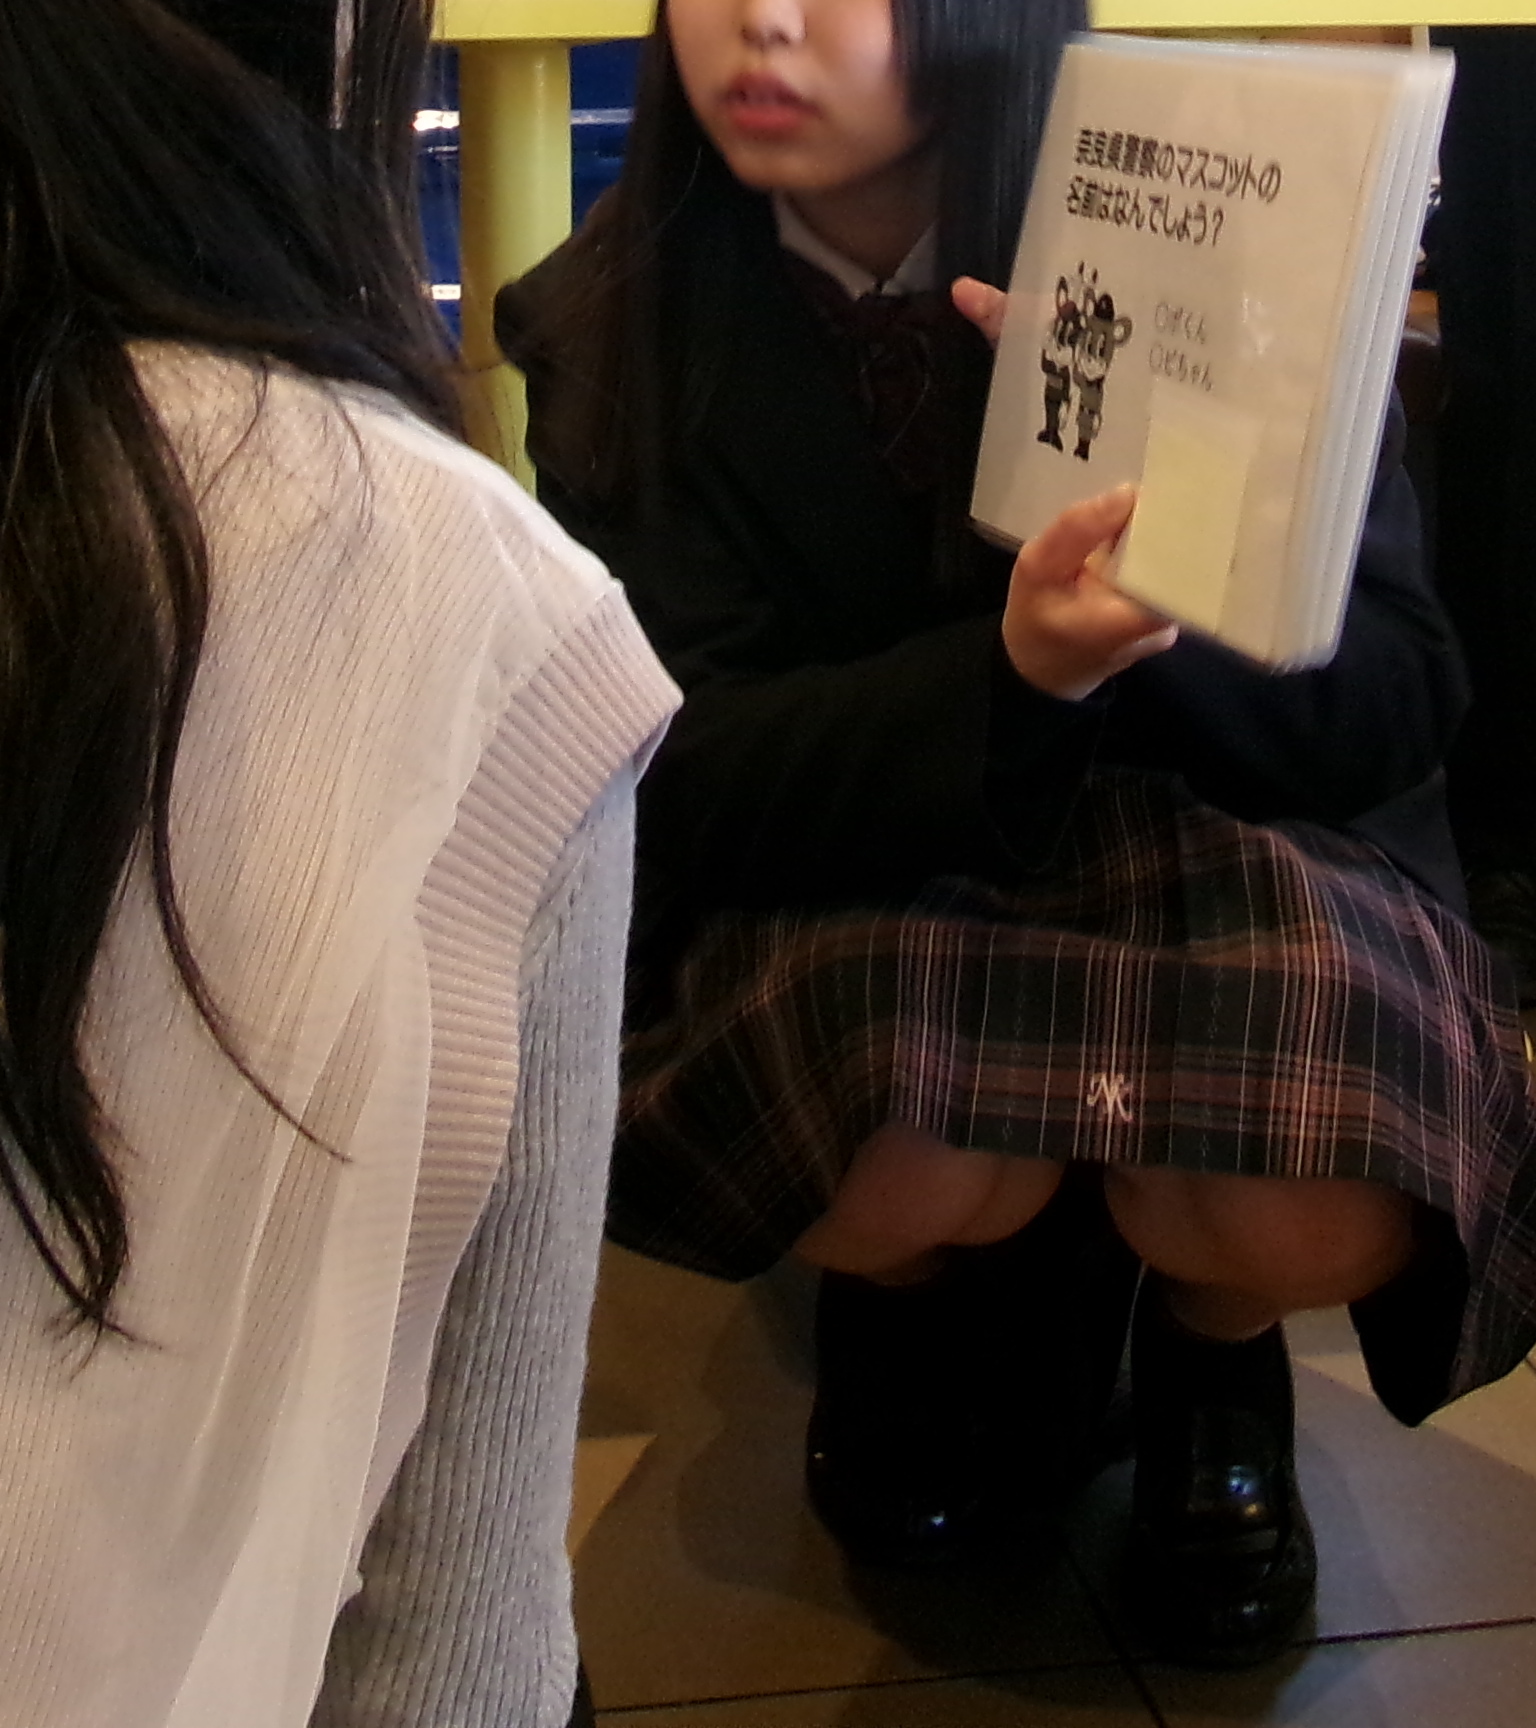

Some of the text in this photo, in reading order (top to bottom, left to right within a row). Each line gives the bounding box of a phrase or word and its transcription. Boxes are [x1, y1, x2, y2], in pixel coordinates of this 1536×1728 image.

[1073, 129, 1283, 203] 奈良県警察のマスコットの
